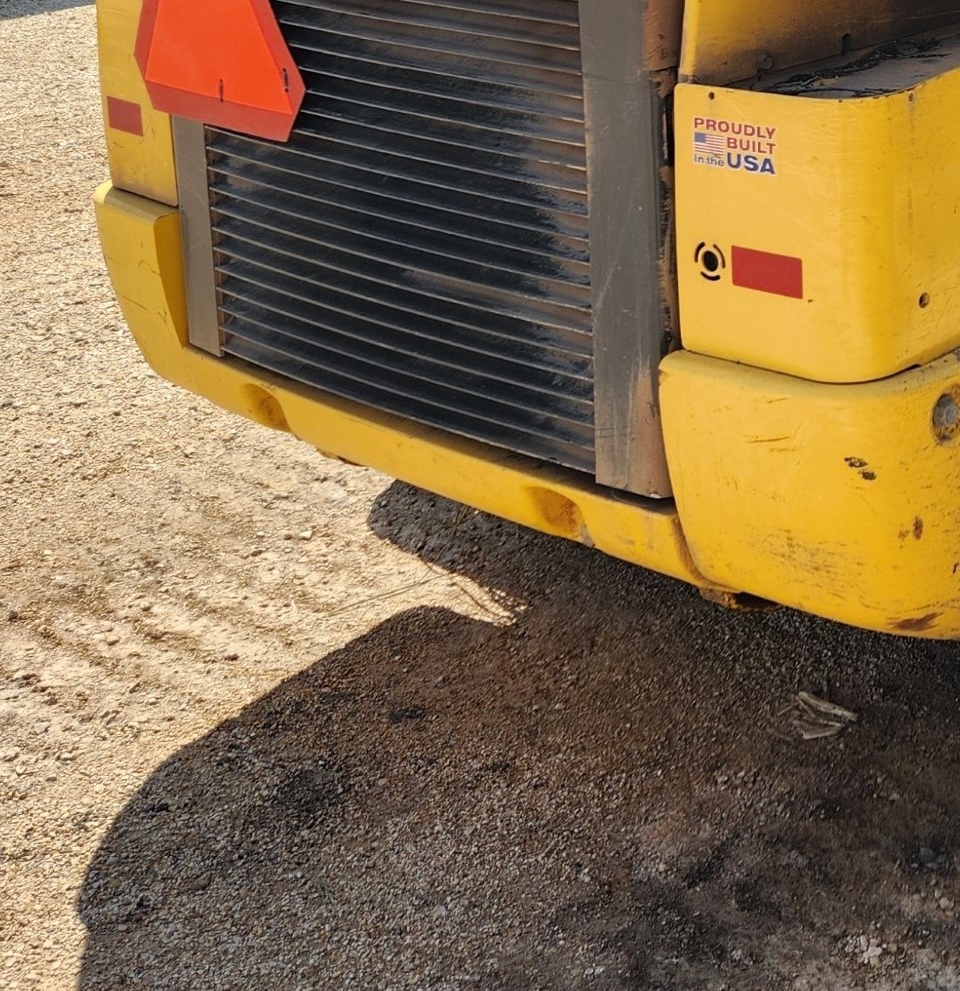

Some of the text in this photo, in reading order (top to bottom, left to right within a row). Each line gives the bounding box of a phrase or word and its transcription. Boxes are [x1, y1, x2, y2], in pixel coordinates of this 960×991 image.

[694, 117, 776, 139] PROUDLY
[726, 136, 776, 155] BUILT
[694, 152, 775, 175] in the USA
